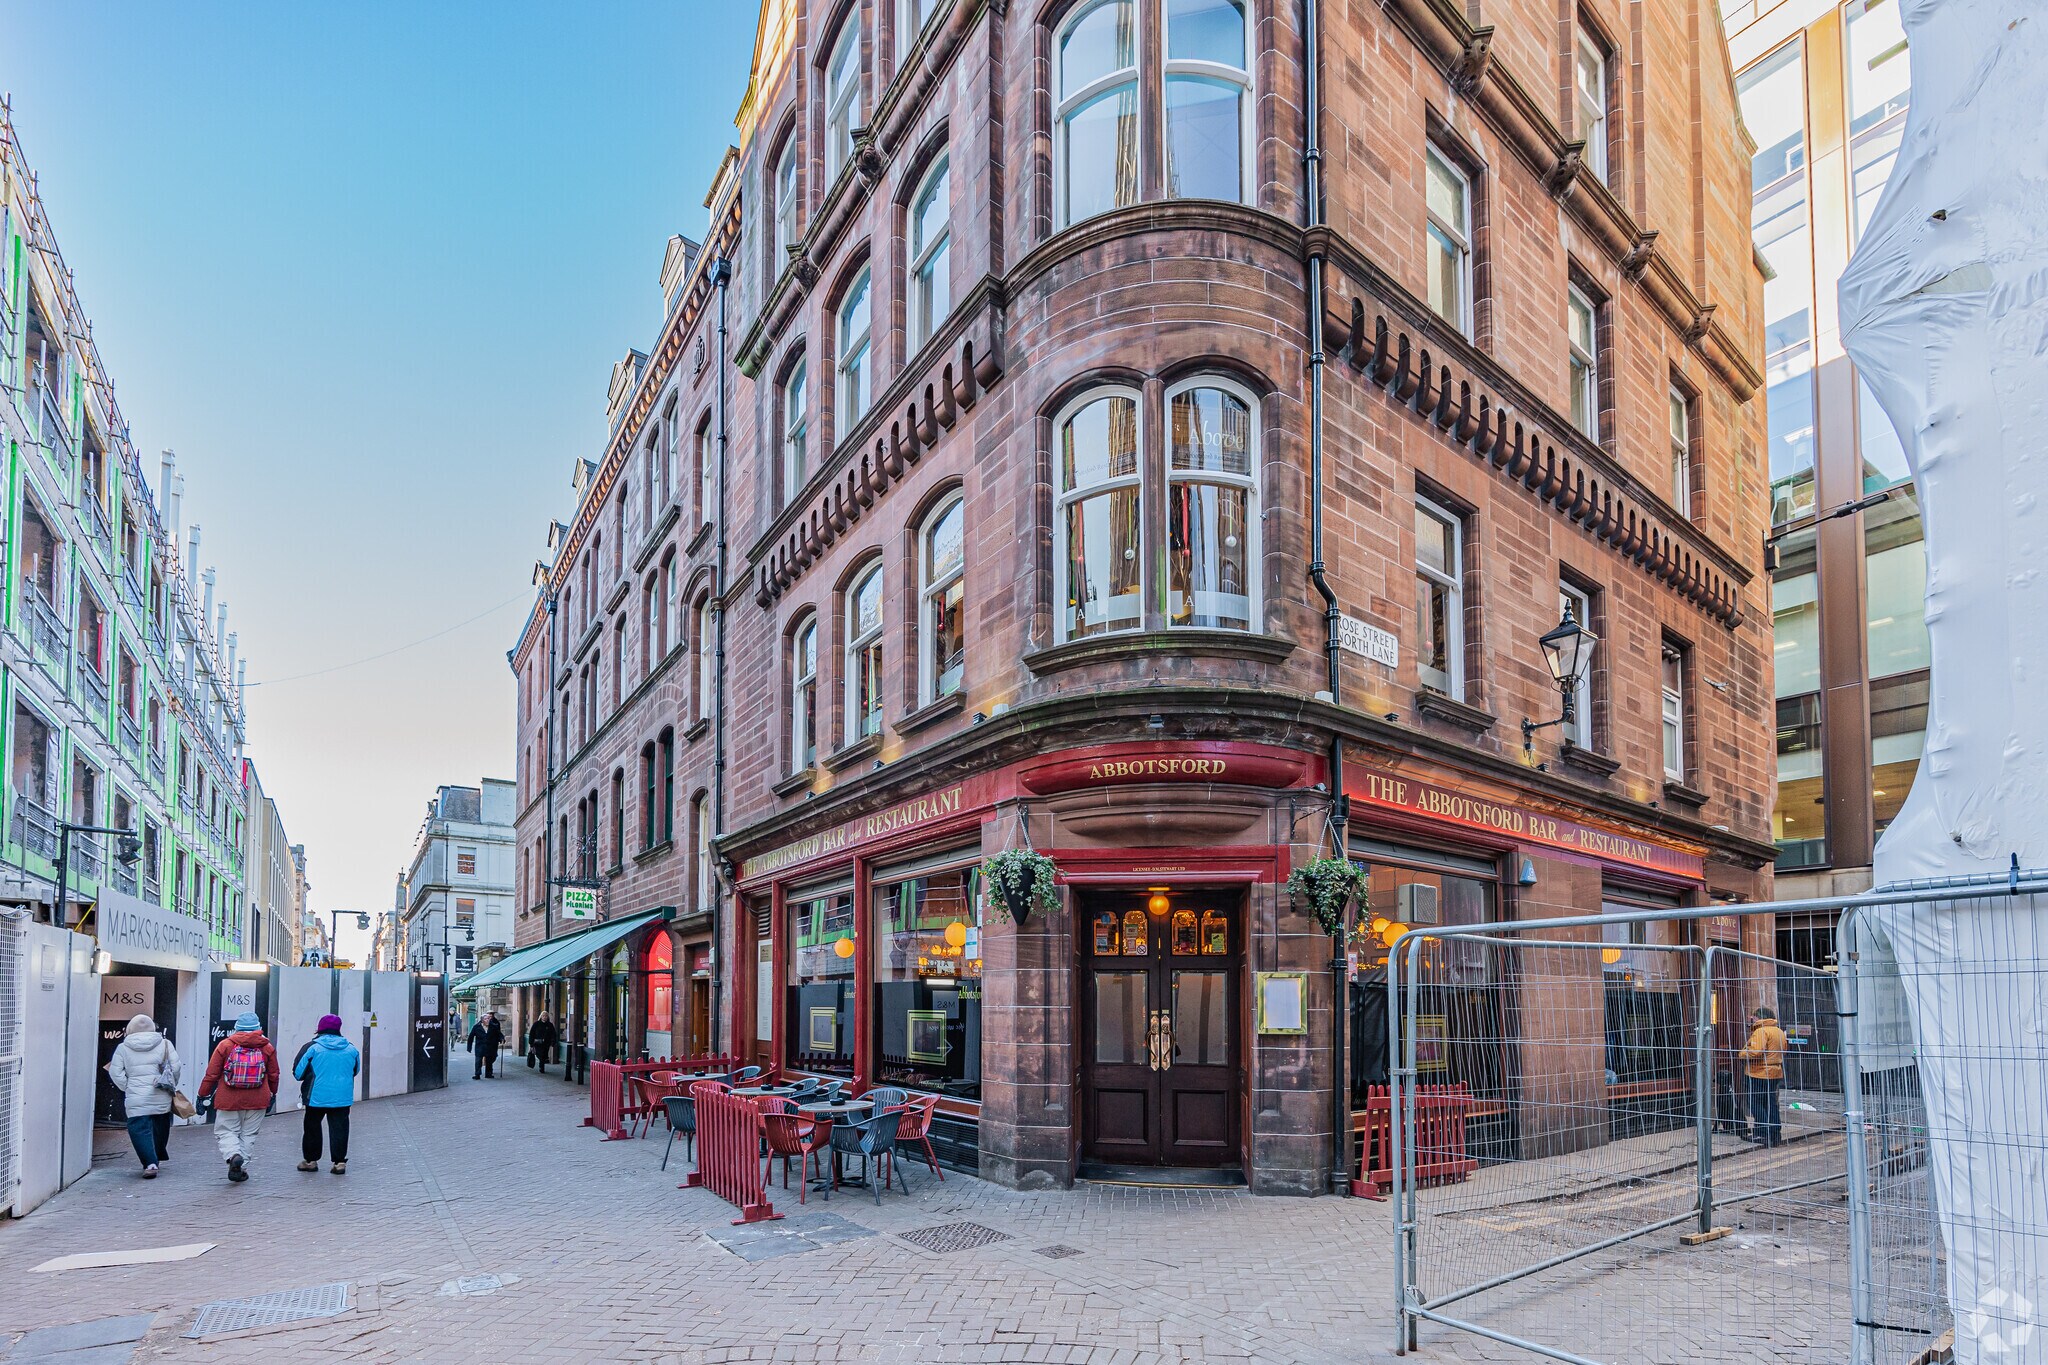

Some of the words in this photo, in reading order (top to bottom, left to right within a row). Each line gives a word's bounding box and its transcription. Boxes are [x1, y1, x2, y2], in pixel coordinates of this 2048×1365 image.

[1186, 420, 1244, 450] Above
[1362, 626, 1396, 650] STREET
[1372, 643, 1395, 664] LANE
[1089, 758, 1226, 779] ABBOTSFORD
[1366, 773, 1408, 806] THE
[1415, 788, 1523, 833] ABBOTSFORD
[1529, 816, 1558, 841] BAR
[1561, 829, 1576, 843] and
[1579, 828, 1651, 863] RESTAURANT
[742, 856, 759, 878] THE
[761, 838, 819, 870] ABBOTSFORD
[823, 828, 846, 850] BAR
[848, 823, 864, 842] and
[866, 787, 963, 838] RESTAURANT
[566, 891, 594, 902] PIZZA
[107, 908, 151, 950] MARKS
[153, 922, 160, 950] &
[162, 923, 204, 959] SPENCER
[104, 992, 145, 1005] M&S
[227, 994, 250, 1006] M&S
